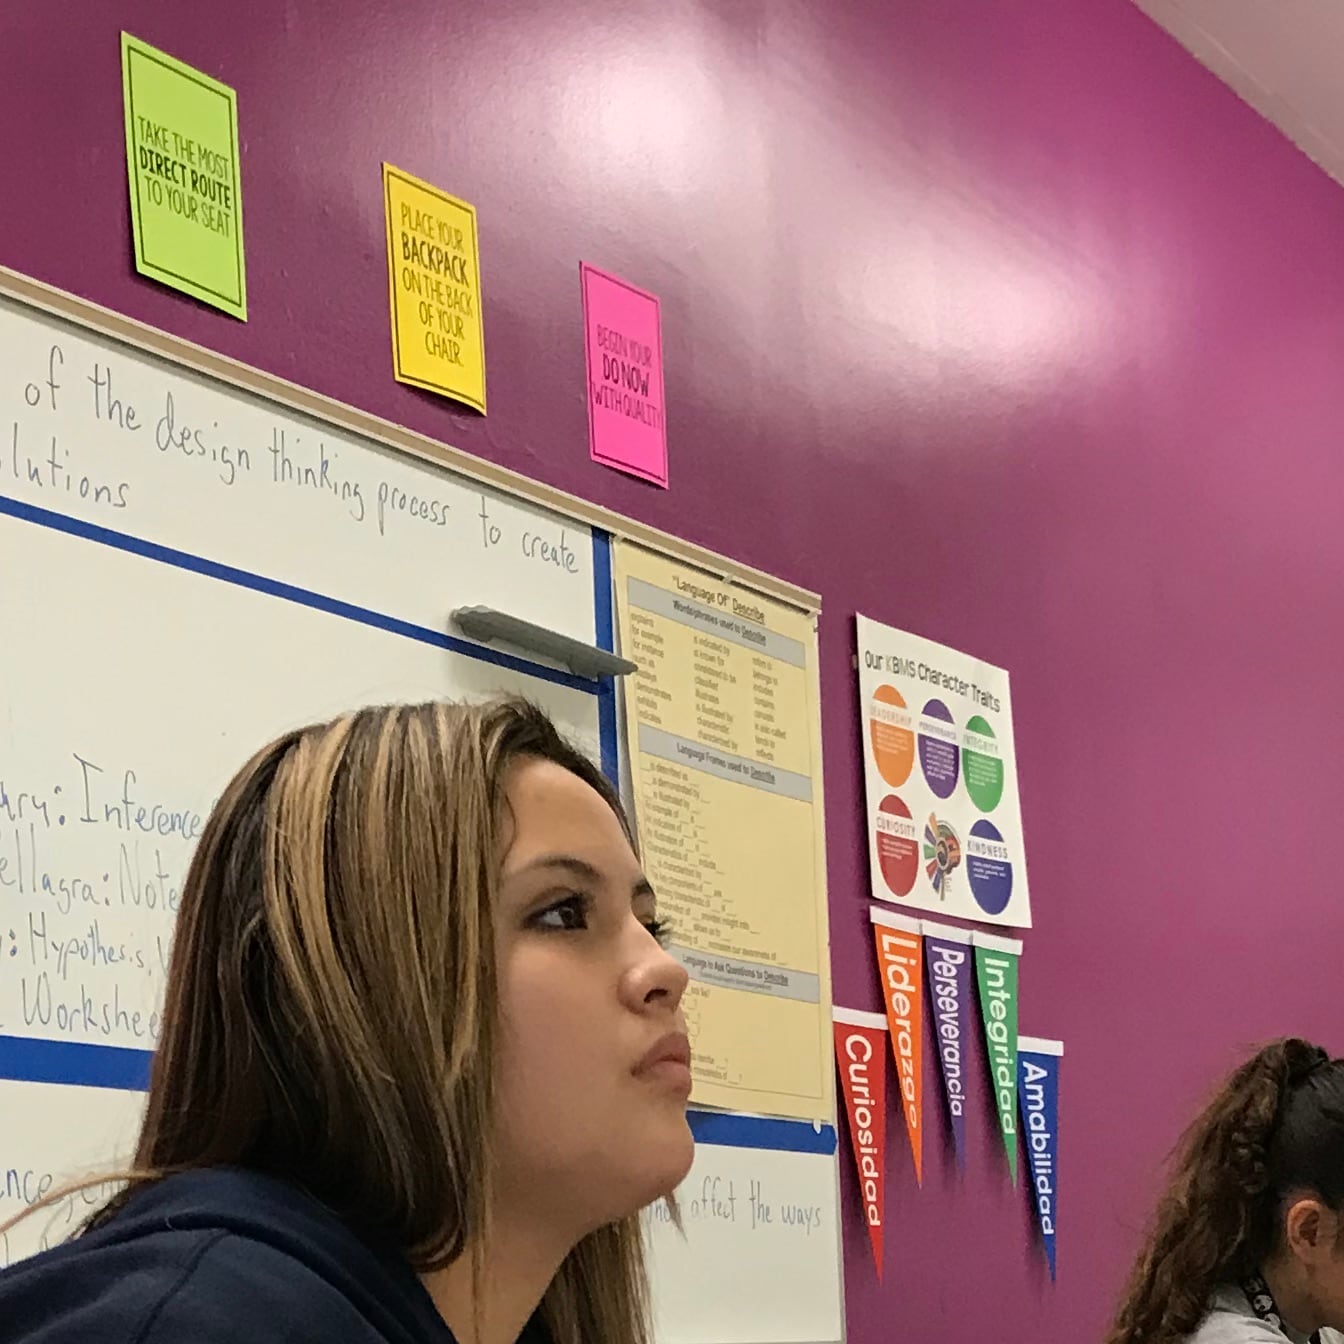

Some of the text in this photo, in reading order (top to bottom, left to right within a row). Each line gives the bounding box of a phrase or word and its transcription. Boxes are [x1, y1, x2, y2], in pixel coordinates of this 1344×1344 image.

[137, 115, 230, 182] TAKE THE MOST
[139, 145, 232, 210] DIRECT ROUTE
[144, 175, 230, 238] TO YOUR SEAT
[400, 201, 463, 252] PLACE YOUR
[401, 232, 470, 289] BACKPACK
[402, 267, 474, 319] ON THE BACK
[419, 301, 465, 340] OF YOUR
[597, 323, 653, 369] BEGIN YOUR
[602, 353, 650, 398] DO NOW
[592, 382, 622, 412] WITH
[25, 346, 63, 410] of
[88, 363, 141, 431] the
[157, 392, 251, 485] design
[268, 428, 364, 521] thinking
[378, 481, 449, 535] process
[479, 496, 501, 549] to
[522, 531, 578, 573] create
[865, 650, 883, 670] Our
[918, 663, 969, 697] Character
[971, 683, 1000, 713] Traits
[968, 840, 1008, 859] KINDNESS
[21, 972, 162, 1039] Workshee
[881, 933, 917, 1129] Liderazgo
[931, 945, 965, 1117] Perseverancia
[984, 958, 1017, 1135] Integridad
[846, 1035, 881, 1227] Curiosidad
[1022, 1061, 1054, 1236] Amabilidad
[749, 1179, 773, 1230] the
[781, 1205, 821, 1236] ways
